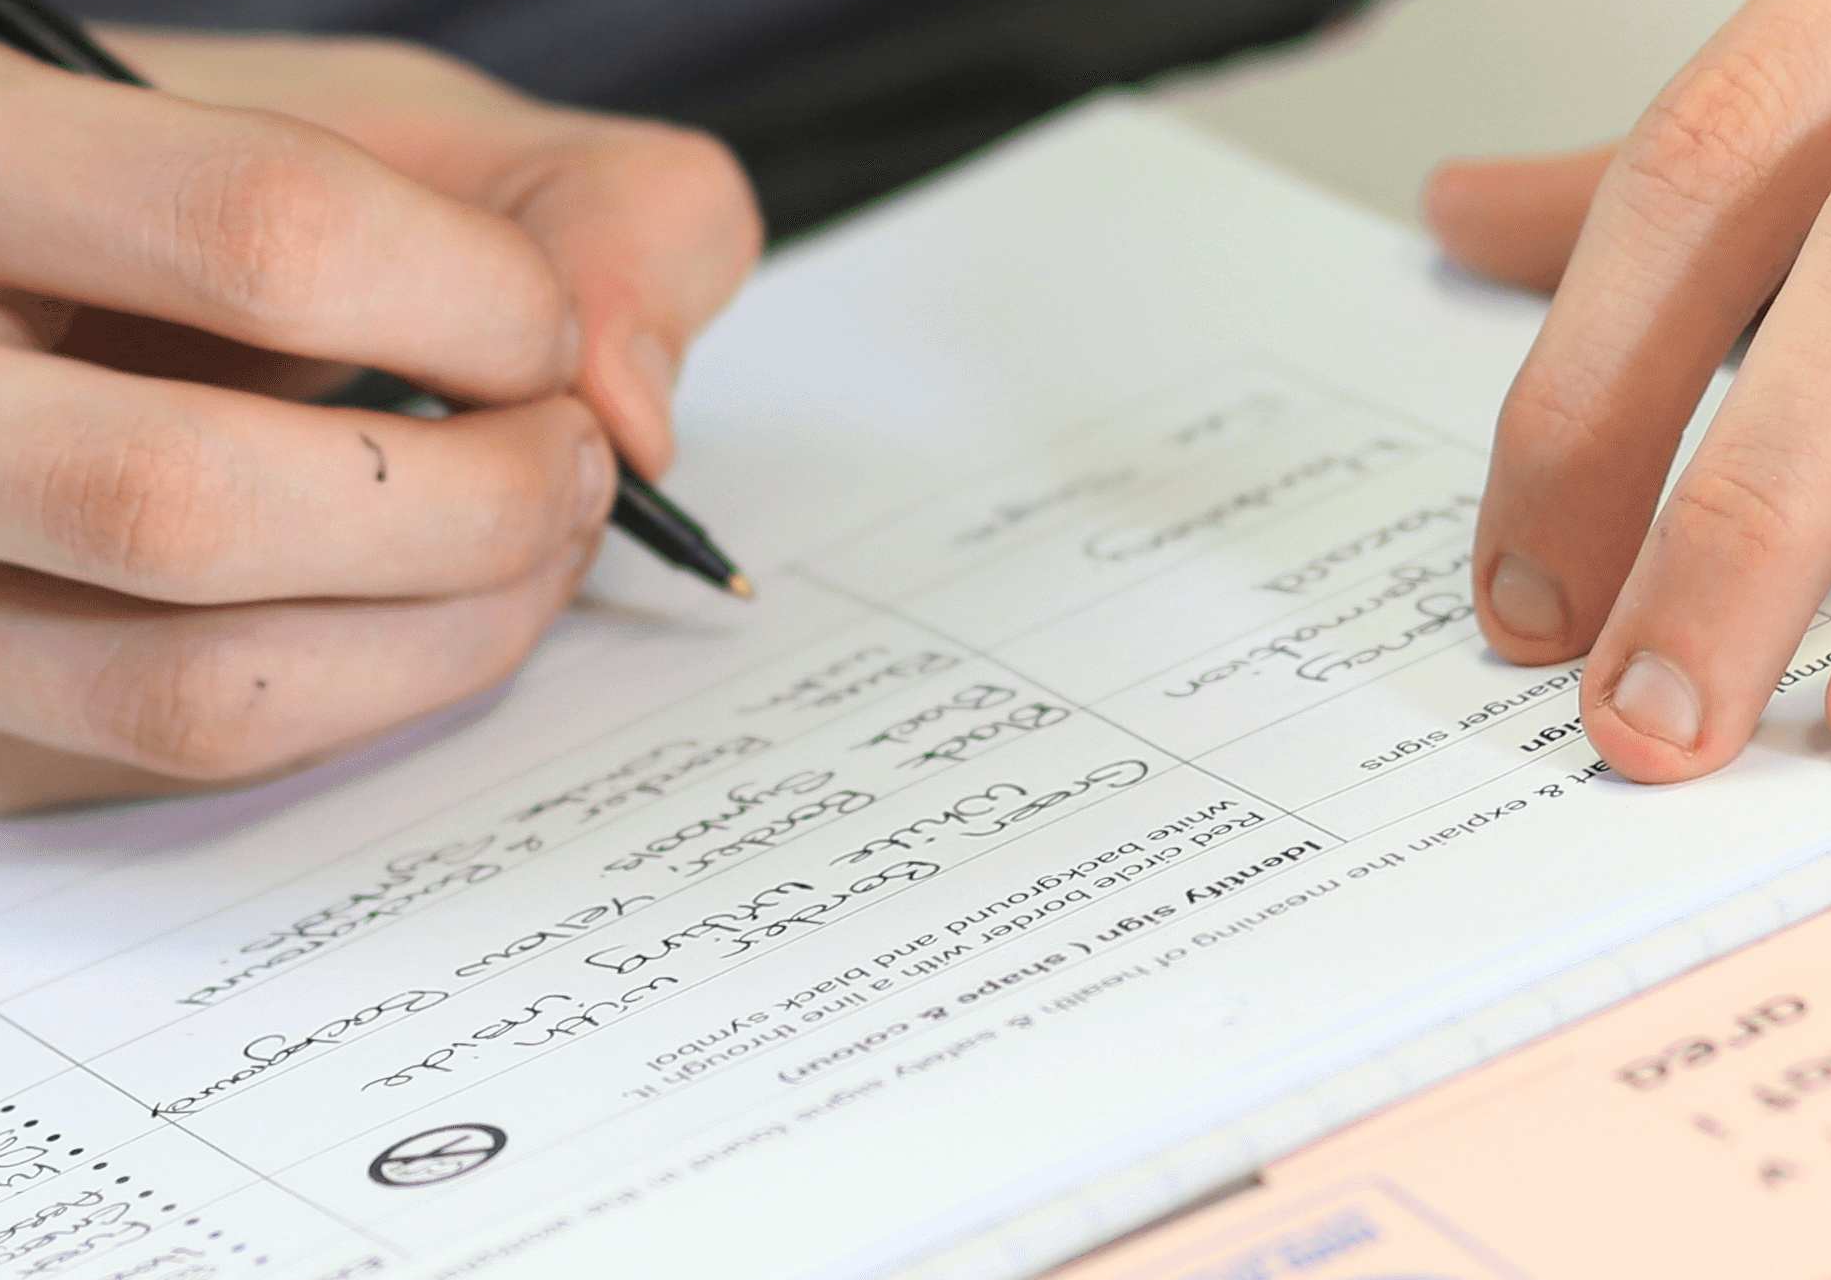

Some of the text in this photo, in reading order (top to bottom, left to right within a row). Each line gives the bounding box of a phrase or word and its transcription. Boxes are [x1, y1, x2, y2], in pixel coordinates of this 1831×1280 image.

[849, 682, 1018, 751] Black
[897, 701, 1073, 768] Black
[1359, 730, 1450, 771] signs
[1533, 783, 1565, 799] &
[1189, 810, 1266, 848] Red
[1407, 798, 1529, 852] explain
[1093, 845, 1183, 889] circle
[1185, 839, 1323, 905] Identify
[1346, 852, 1406, 879] the
[513, 758, 1150, 1047] Green Border with
[981, 888, 1093, 944] border
[1096, 904, 1177, 943] sign
[1190, 878, 1342, 948] meaning
[645, 800, 1238, 1072] white background and black symbol
[900, 944, 973, 978] with
[1154, 947, 1188, 969] of
[800, 991, 869, 1023] line
[868, 977, 894, 992] a
[360, 993, 585, 1092] inside
[664, 1023, 798, 1085] through
[1615, 995, 1810, 1091] area
